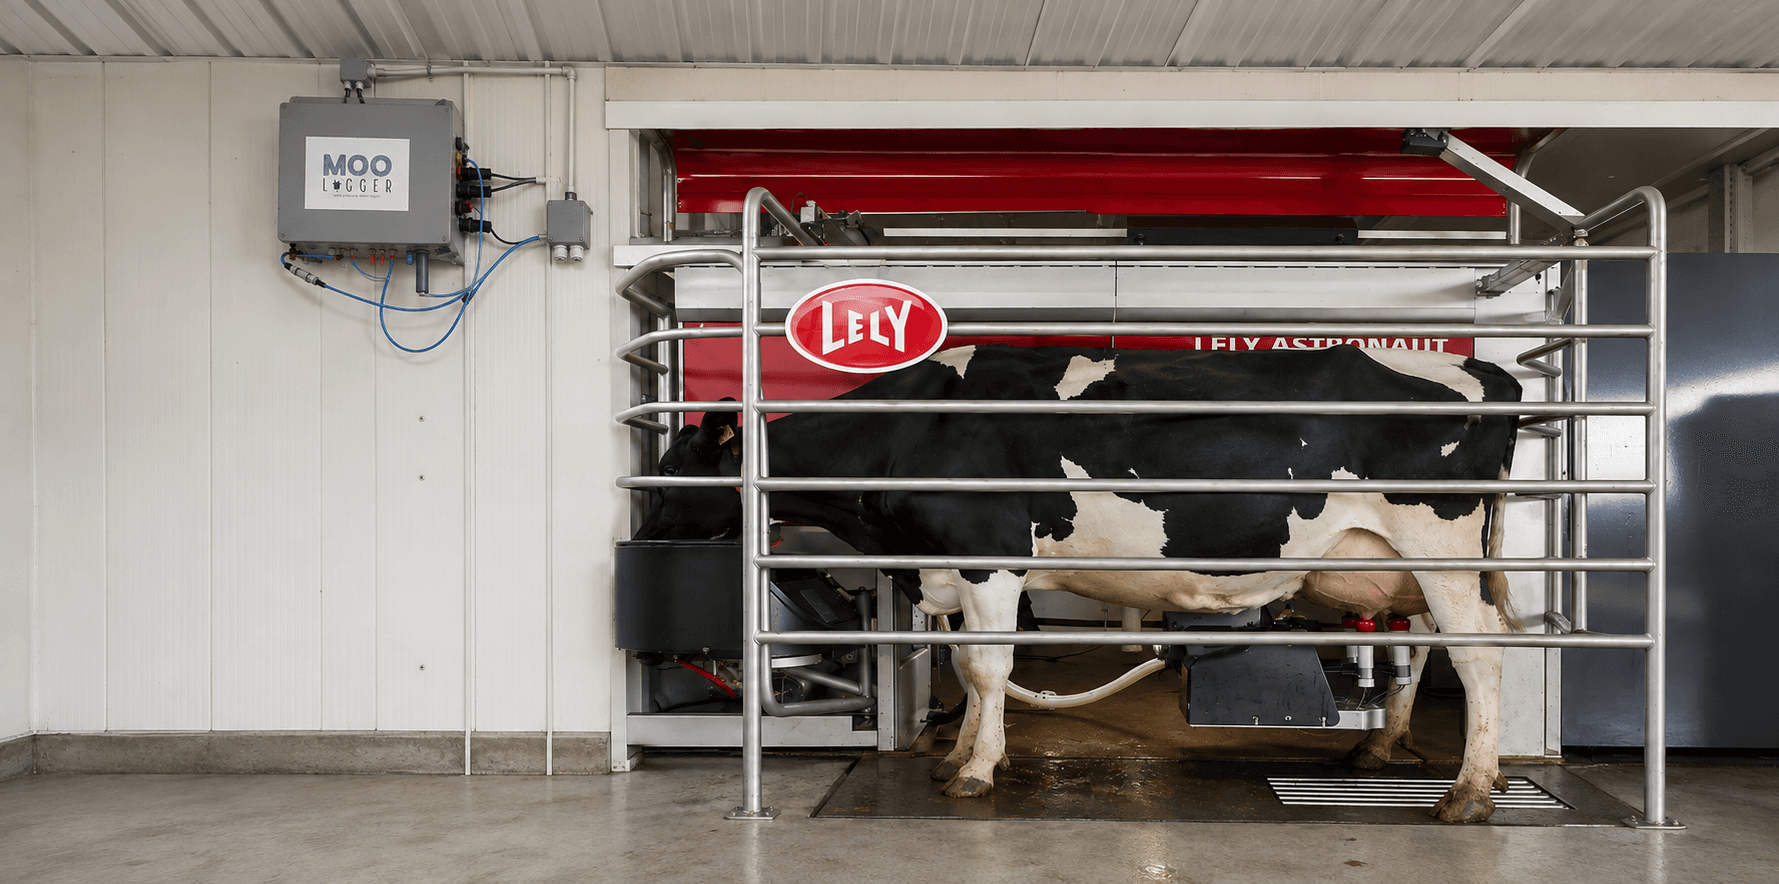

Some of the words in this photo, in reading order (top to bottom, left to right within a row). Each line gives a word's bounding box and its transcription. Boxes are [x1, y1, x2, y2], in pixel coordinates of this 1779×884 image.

[323, 154, 392, 177] MOO
[322, 178, 392, 193] LGGER
[822, 300, 912, 356] LELY
